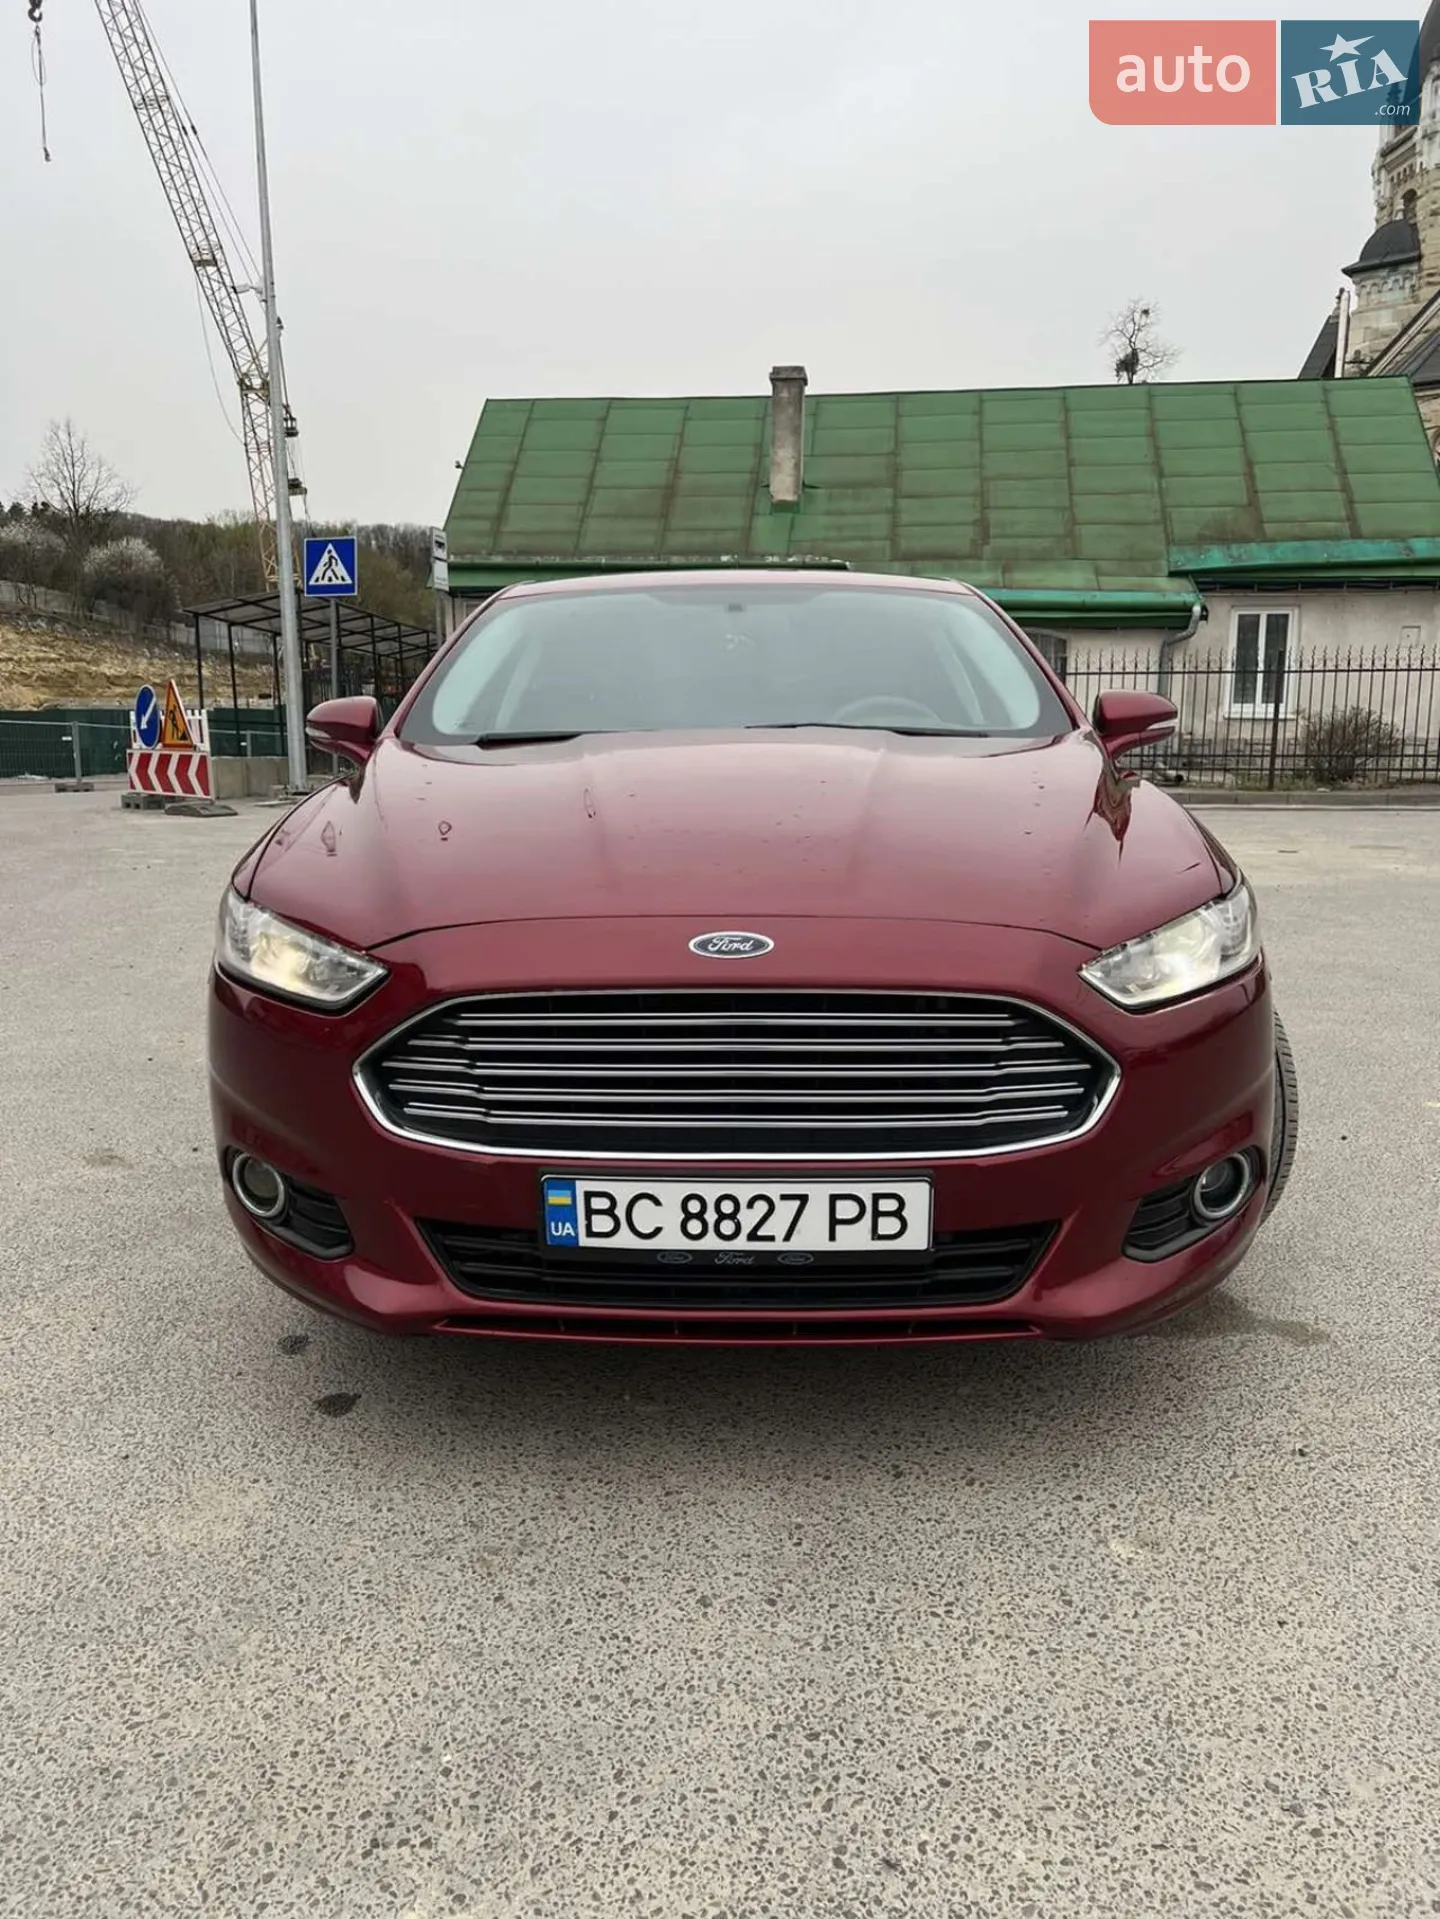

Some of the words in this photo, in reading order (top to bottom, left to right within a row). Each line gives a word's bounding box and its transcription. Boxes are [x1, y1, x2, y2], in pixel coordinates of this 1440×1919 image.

[707, 936, 754, 952] Ford
[584, 1190, 663, 1240] BC
[680, 1192, 810, 1242] 8827
[828, 1192, 909, 1242] PB
[551, 1221, 575, 1237] UA
[714, 1251, 755, 1265] Ford
